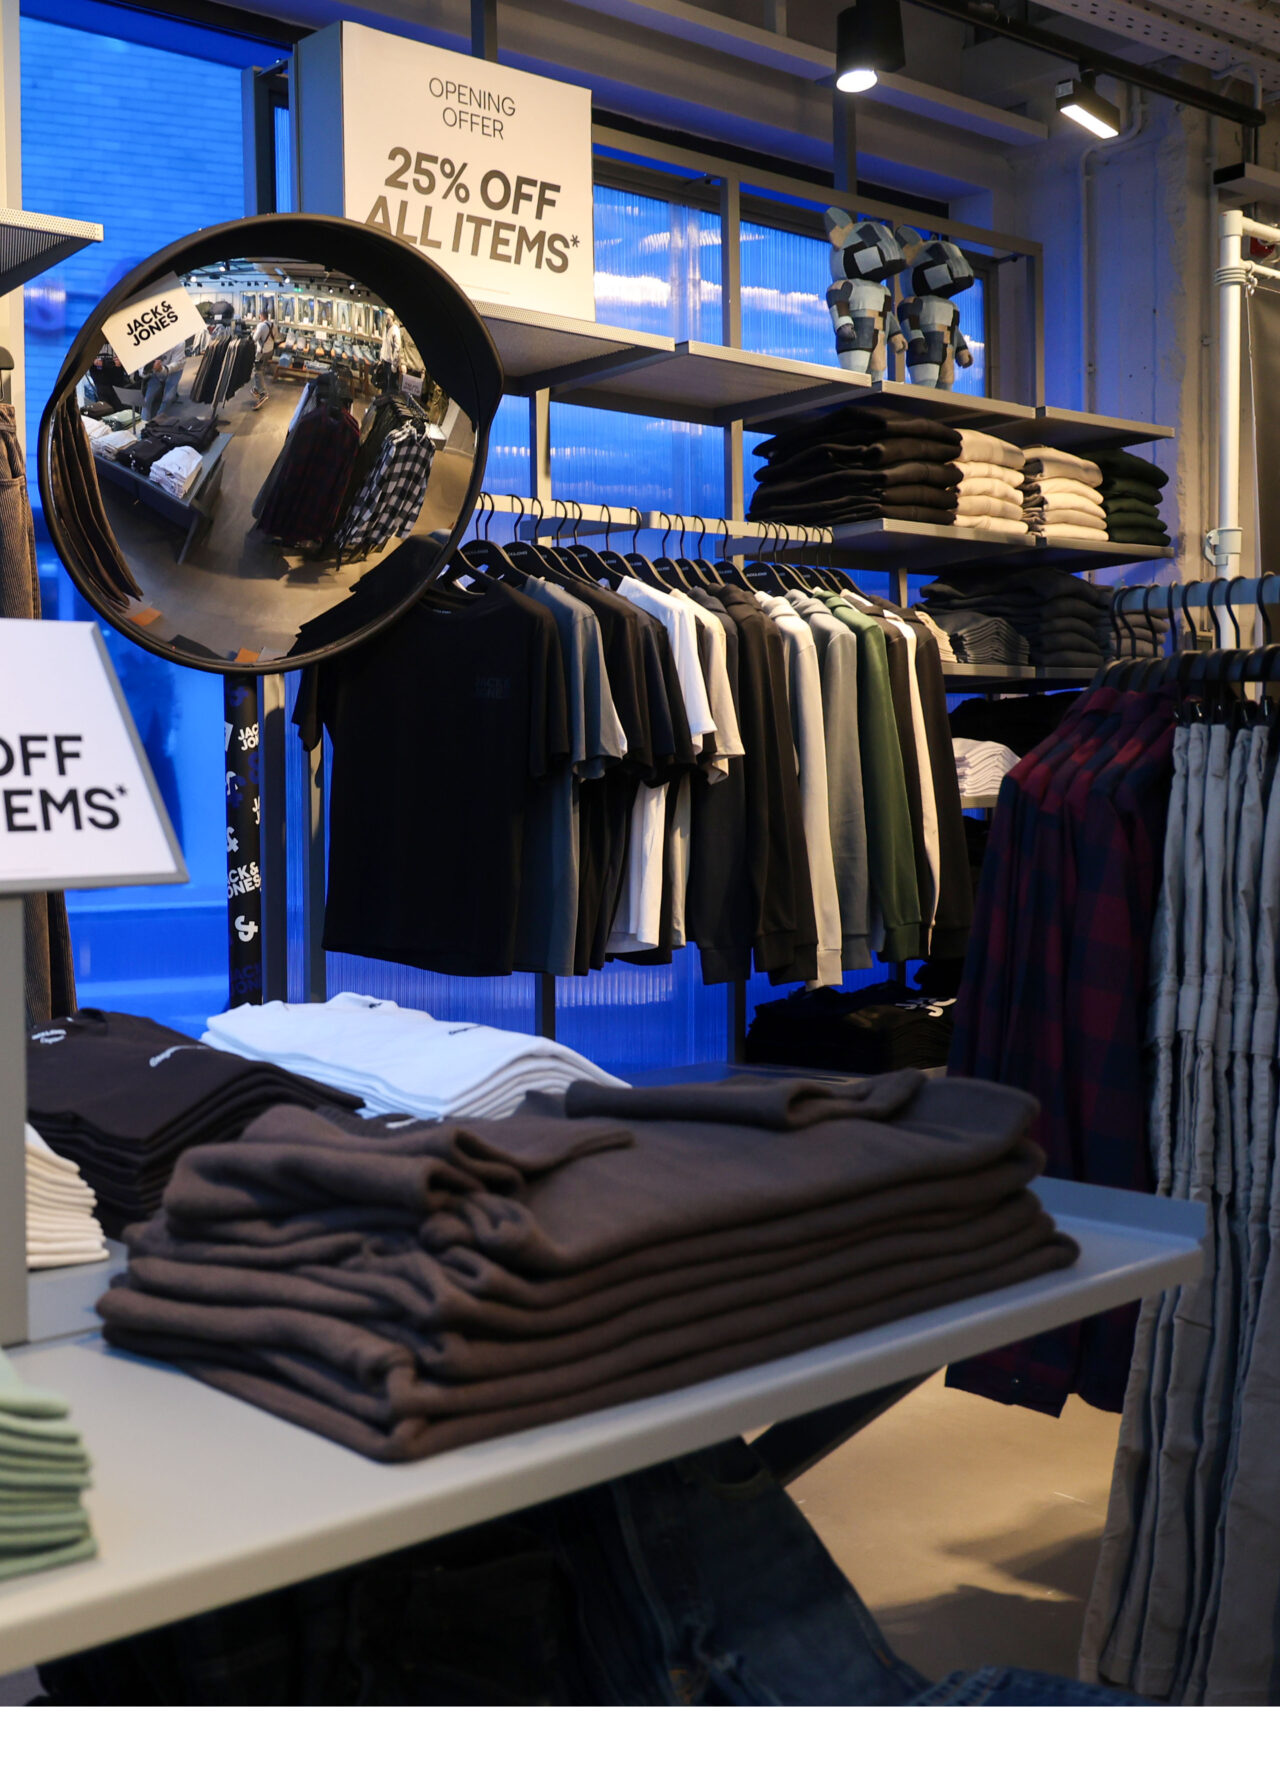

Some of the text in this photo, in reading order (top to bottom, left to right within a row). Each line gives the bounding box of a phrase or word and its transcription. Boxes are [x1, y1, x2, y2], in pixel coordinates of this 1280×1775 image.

[428, 77, 516, 117] OPENING
[442, 107, 504, 140] OFFER
[384, 146, 562, 220] 25% OFF
[365, 195, 442, 250] ALL
[126, 300, 173, 336] JACK&
[133, 311, 179, 346] JONES
